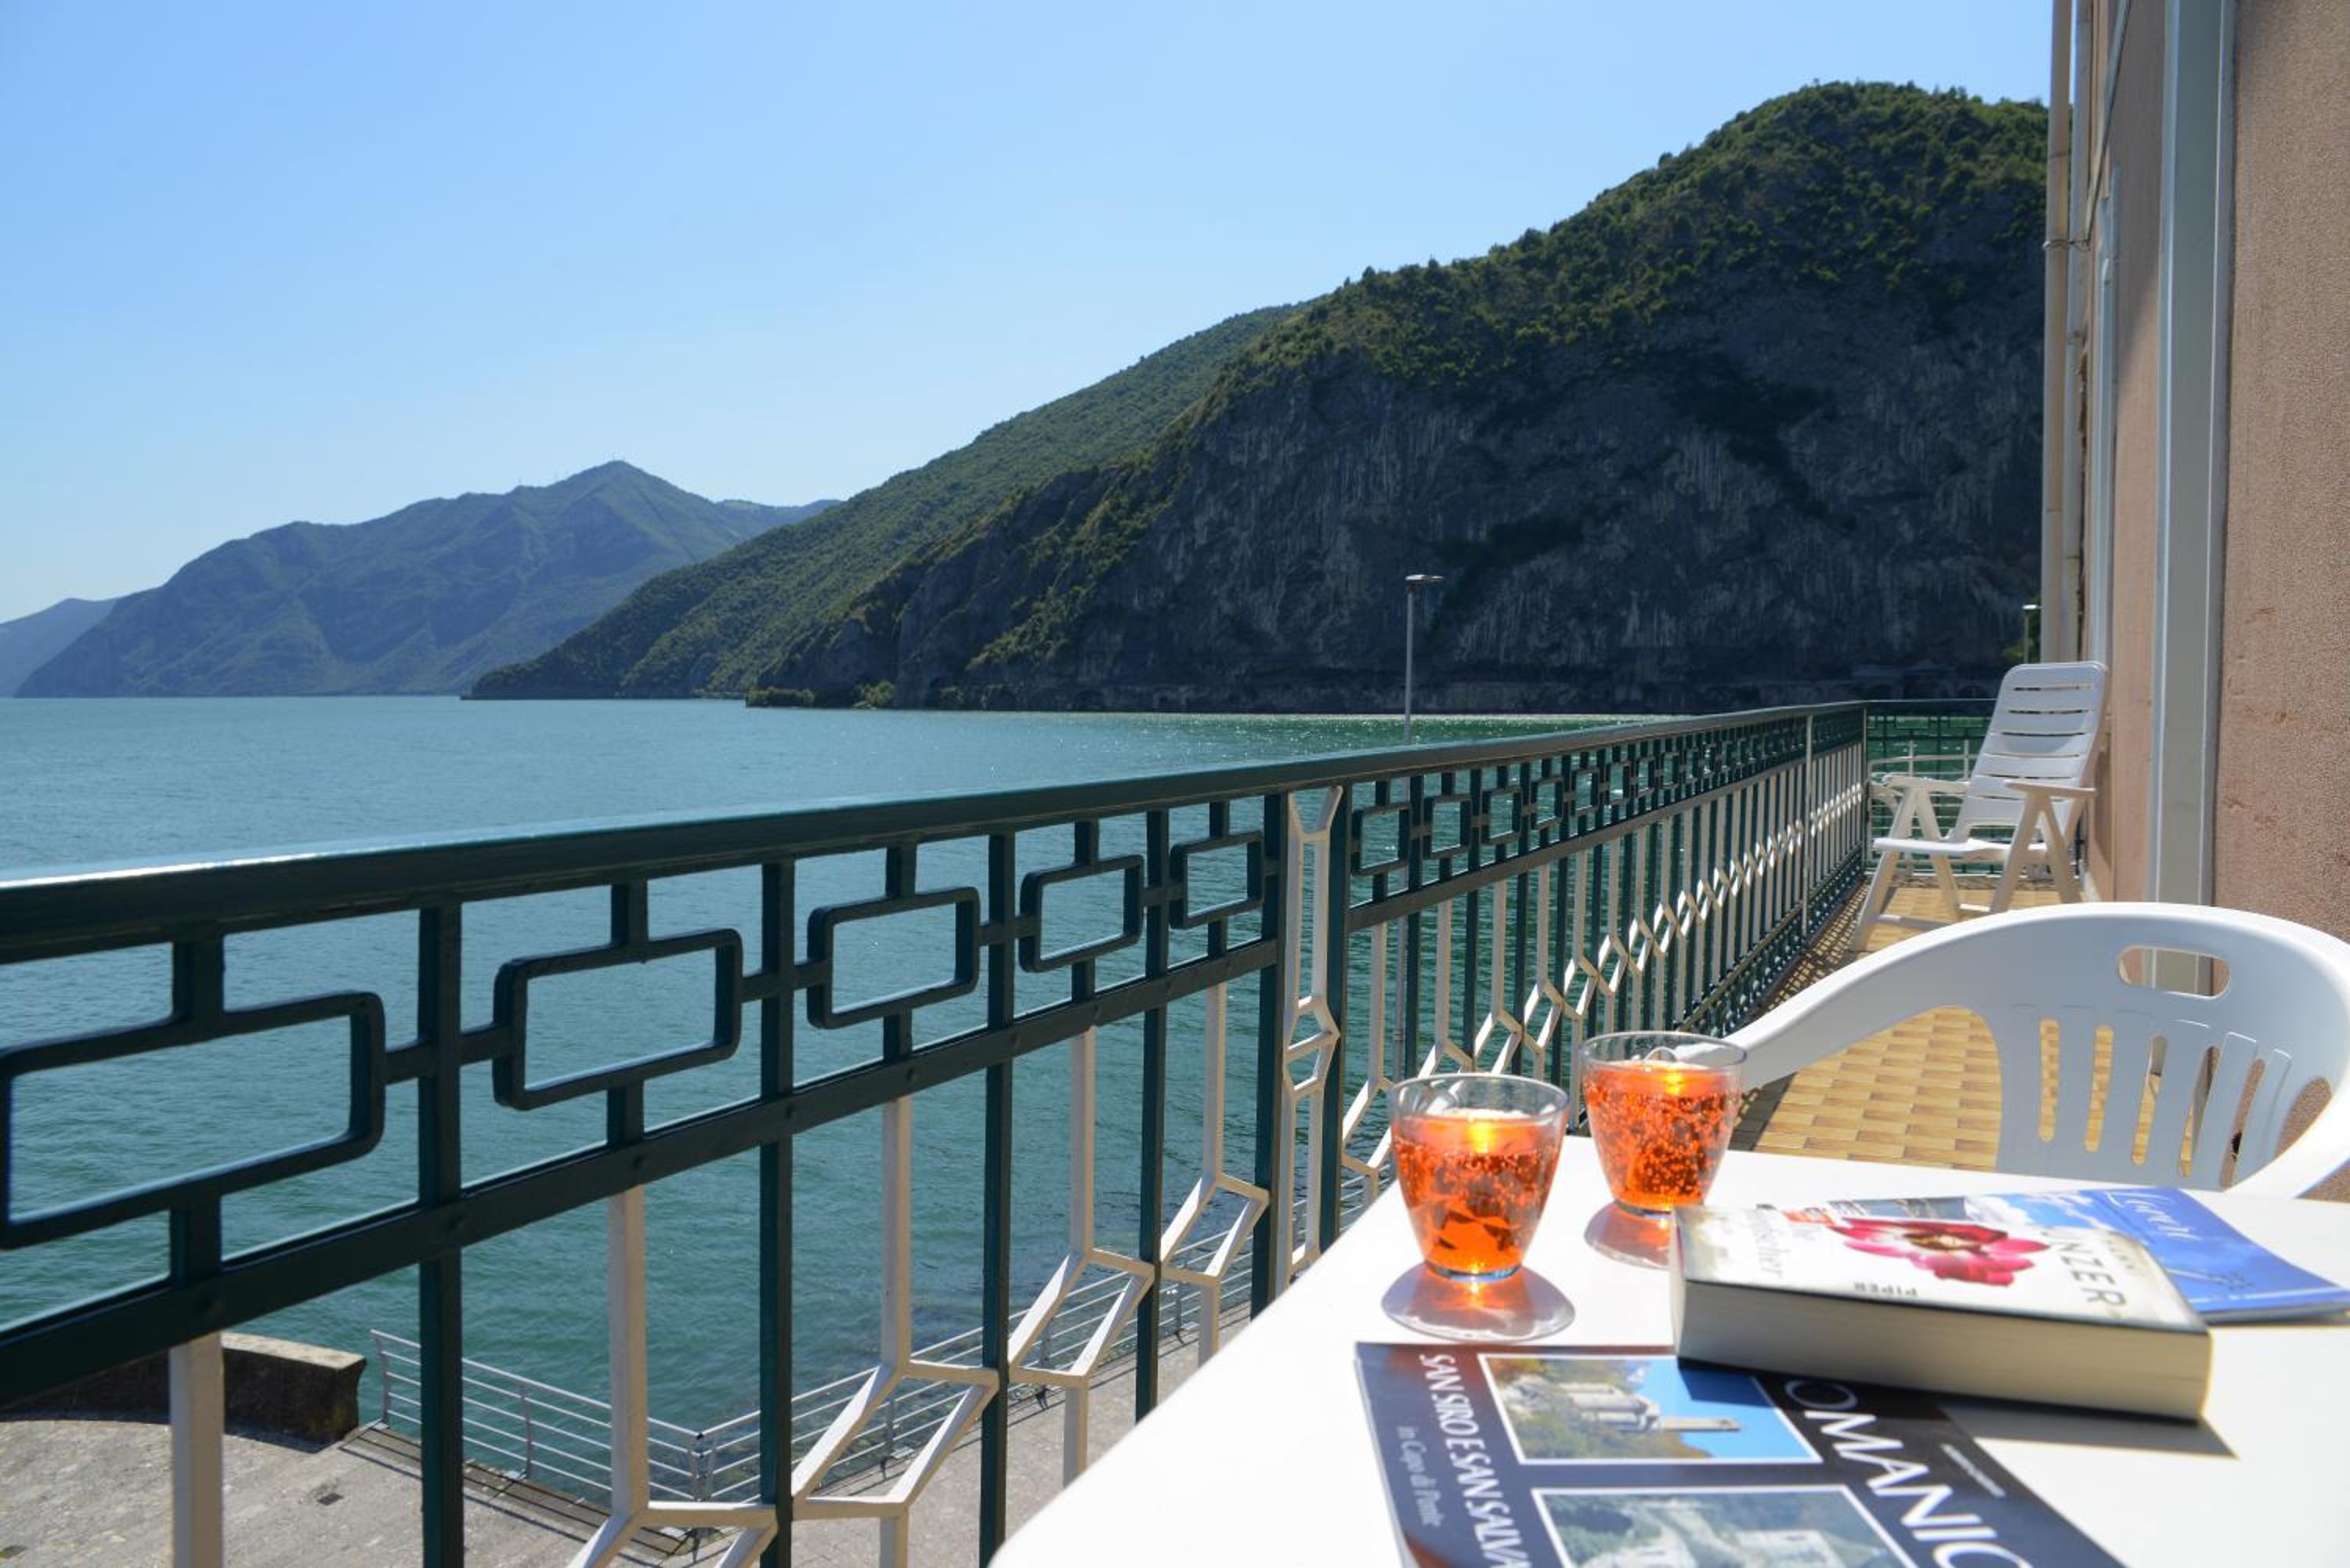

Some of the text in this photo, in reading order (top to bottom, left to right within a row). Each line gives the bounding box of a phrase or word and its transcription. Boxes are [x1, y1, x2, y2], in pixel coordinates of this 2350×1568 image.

[1419, 1353, 1533, 1568] SAN SIRO E SAN SALVA
[1784, 1378, 2034, 1568] OMANIC
